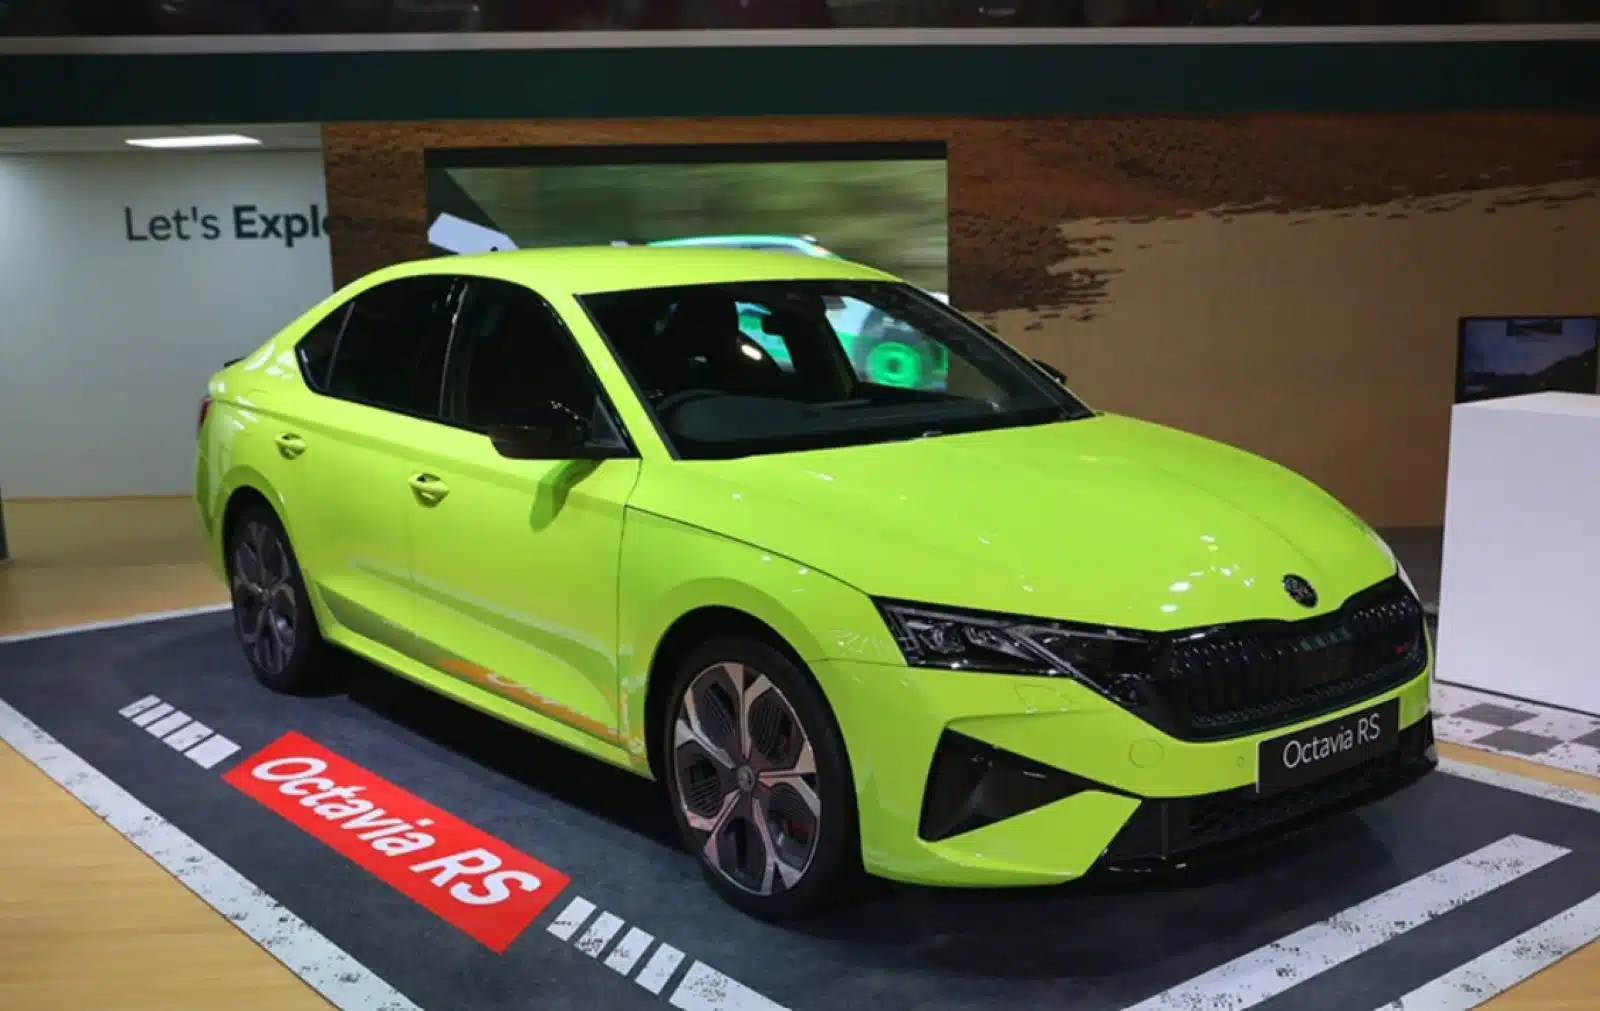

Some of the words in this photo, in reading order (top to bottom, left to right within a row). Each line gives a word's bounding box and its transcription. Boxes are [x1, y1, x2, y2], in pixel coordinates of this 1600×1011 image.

[124, 205, 221, 242] Let's
[1282, 725, 1354, 769] Octavia
[1356, 712, 1381, 743] RS
[252, 756, 435, 857] Octavia
[410, 848, 541, 906] RS
